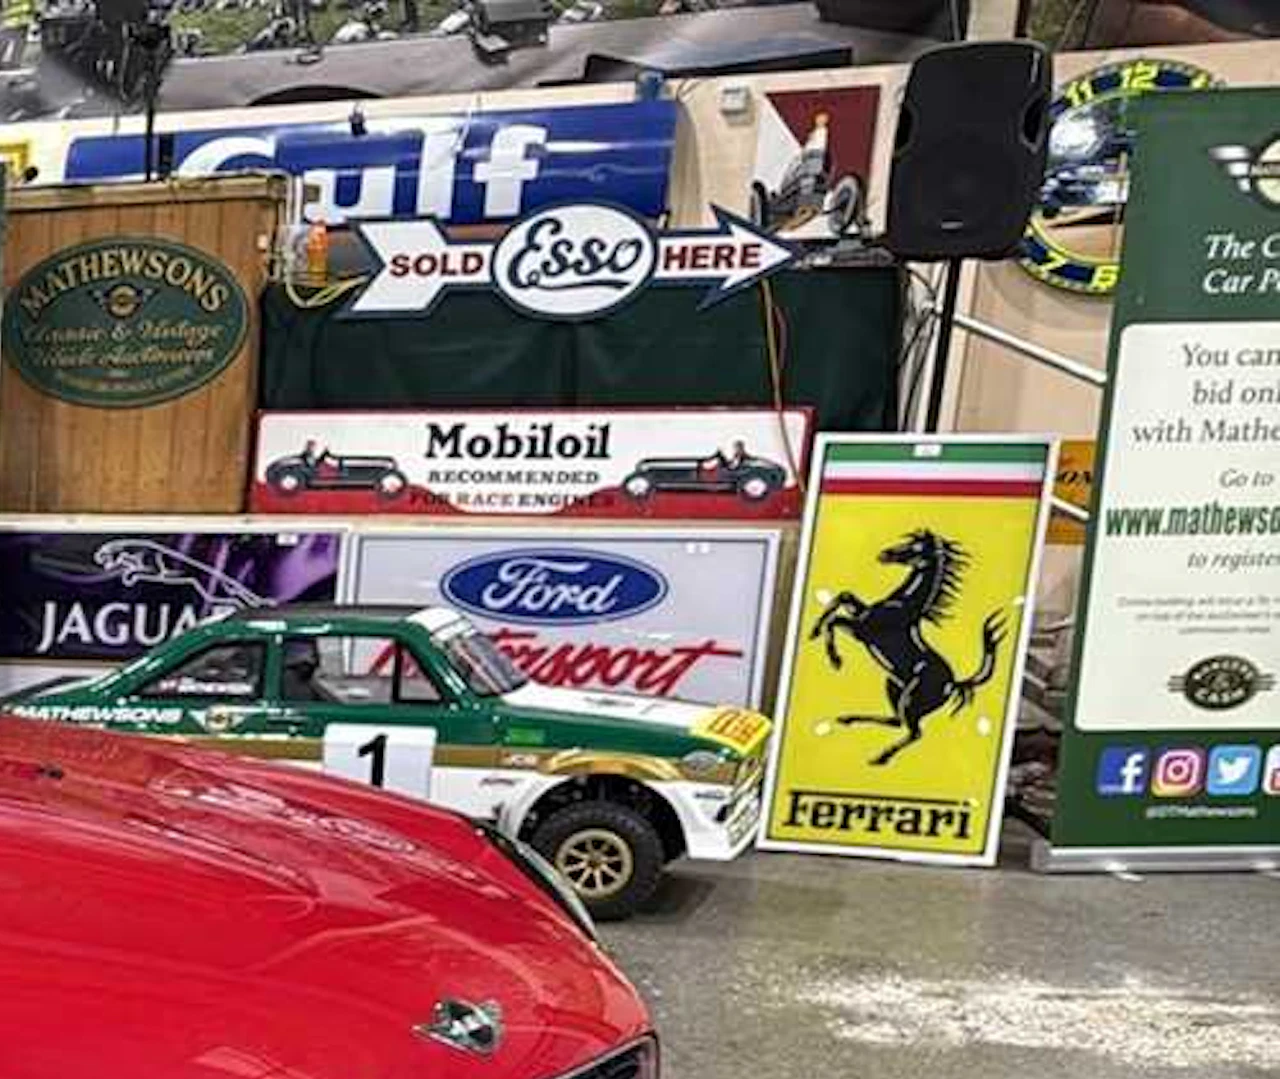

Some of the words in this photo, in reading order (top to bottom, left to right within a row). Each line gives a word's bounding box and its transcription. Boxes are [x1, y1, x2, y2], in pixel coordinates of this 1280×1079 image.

[1120, 62, 1158, 89] 12
[506, 217, 643, 290] Esso
[661, 243, 766, 272] HERE
[1203, 233, 1256, 260] The
[389, 253, 485, 279] SOLD
[19, 247, 229, 323] MATHEWSONS
[1202, 268, 1254, 294] Car
[1181, 342, 1229, 367] You
[1192, 379, 1233, 405] bid
[424, 423, 612, 461] Mobiloil
[1132, 417, 1191, 443] with
[427, 470, 602, 486] RECOMMENDED
[1218, 468, 1249, 488] Go
[1252, 469, 1275, 487] to
[454, 492, 515, 507] RACE
[1187, 552, 1207, 569] to
[482, 557, 625, 614] Ford
[37, 600, 236, 653] JAGUA
[357, 733, 389, 790] 1
[782, 790, 971, 840] Ferrari
